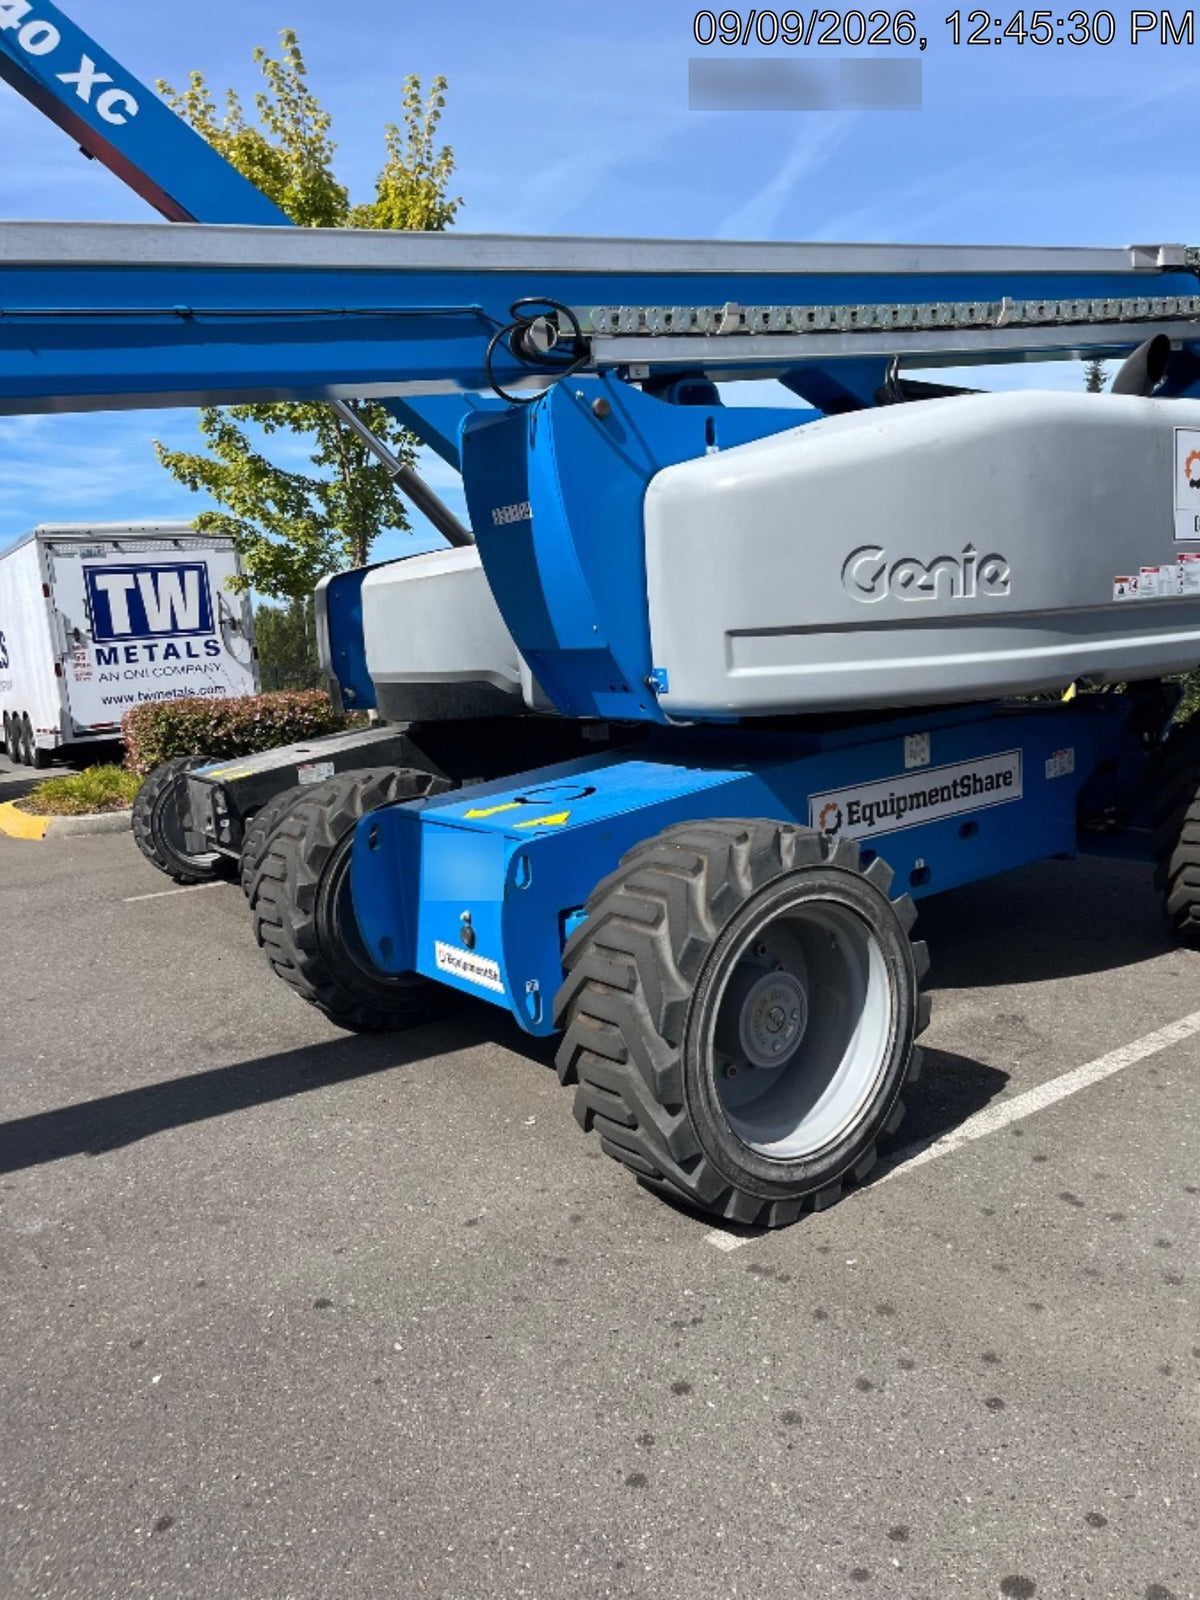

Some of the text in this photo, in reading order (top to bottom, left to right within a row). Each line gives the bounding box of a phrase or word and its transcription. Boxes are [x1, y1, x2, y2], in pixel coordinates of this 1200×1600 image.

[55, 53, 139, 125] XC
[840, 542, 1011, 603] Genie
[95, 570, 200, 635] TW
[96, 639, 221, 666] METALS
[99, 672, 120, 683] AN
[152, 662, 221, 678] COMPANY
[101, 685, 226, 705] www.twmetals.com
[846, 771, 1013, 827] EquipmentShare
